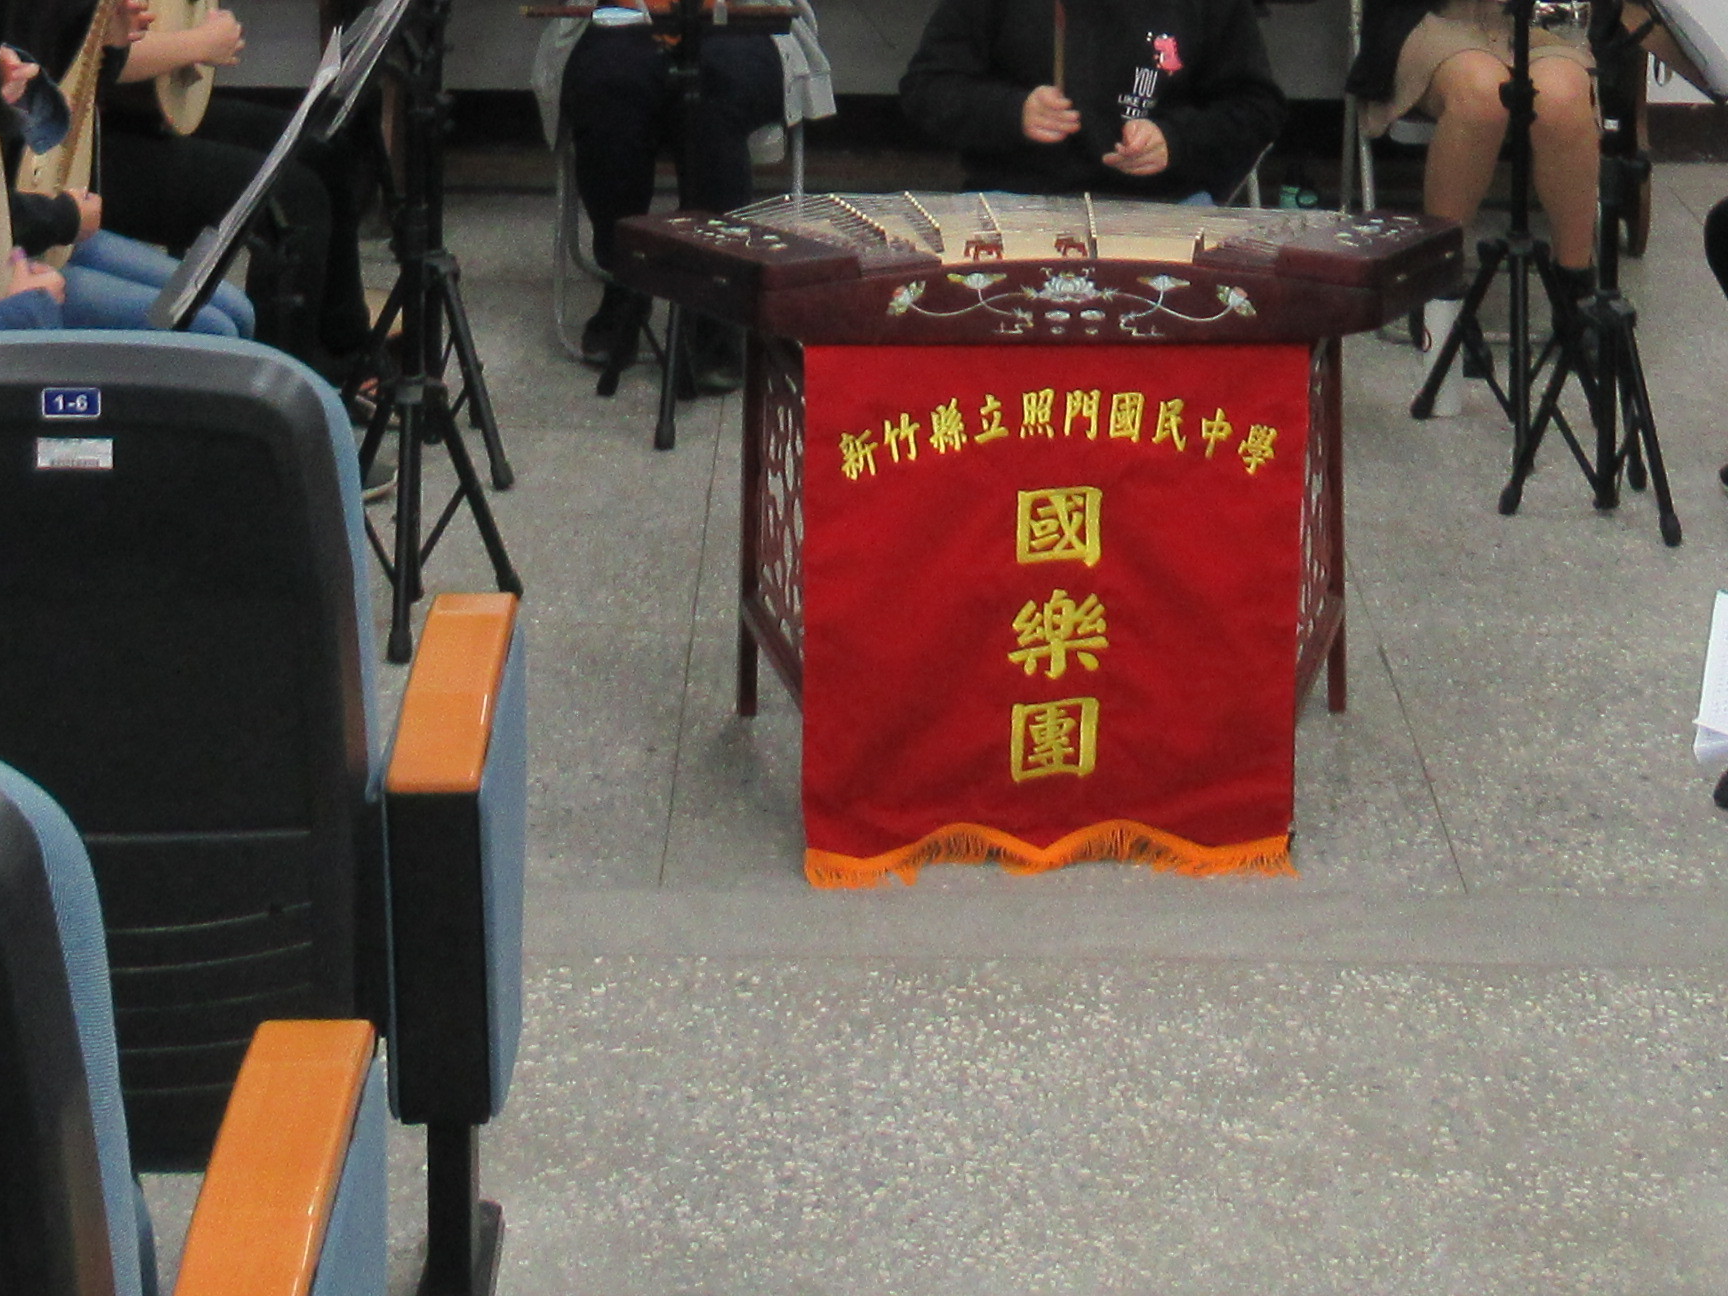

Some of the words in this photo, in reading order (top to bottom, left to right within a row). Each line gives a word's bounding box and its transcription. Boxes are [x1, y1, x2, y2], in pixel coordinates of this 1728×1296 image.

[1132, 66, 1159, 98] YOU
[52, 393, 89, 412] 1-6
[837, 387, 1278, 481] 新竹縣立照門國民中學
[1007, 485, 1110, 783] 國樂團
